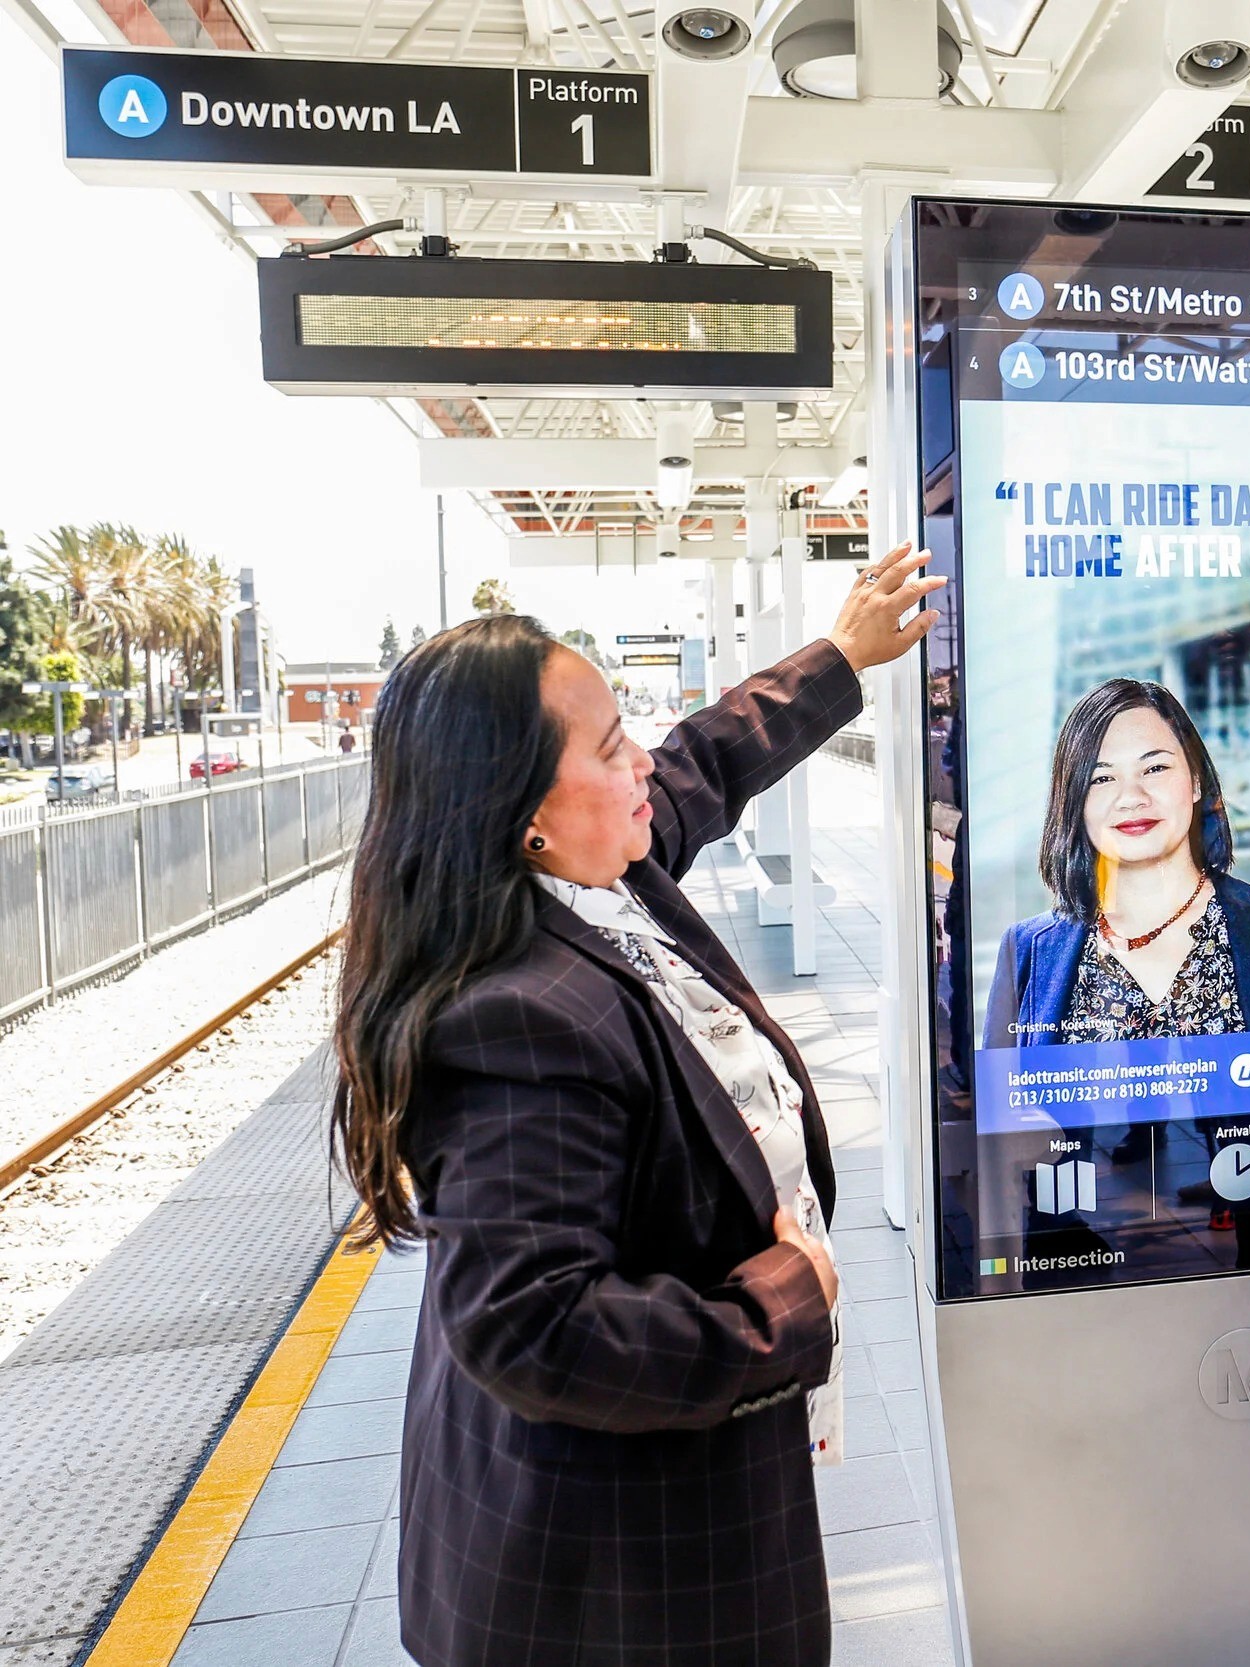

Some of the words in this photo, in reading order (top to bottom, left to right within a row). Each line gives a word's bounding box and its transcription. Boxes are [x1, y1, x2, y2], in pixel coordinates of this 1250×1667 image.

[529, 78, 638, 104] Platform
[117, 89, 149, 124] A
[181, 91, 395, 132] Downtown
[407, 100, 462, 134] LA
[571, 114, 594, 166] 1
[1184, 142, 1216, 191] 2
[968, 287, 978, 301] 3
[1010, 283, 1034, 311] A
[1053, 283, 1102, 312] 7th
[1110, 285, 1242, 317] St/Metro
[969, 356, 979, 370] 4
[1011, 351, 1035, 380] A
[1055, 351, 1135, 381] 103rd
[1044, 482, 1112, 526] CAN
[1122, 483, 1200, 526] RIDE
[1025, 534, 1123, 577] HOME
[1135, 534, 1242, 578] AFTER
[1007, 1021, 1059, 1034] Christine,
[1060, 1017, 1119, 1031] Koreatown
[1008, 1058, 1218, 1087] ladottransit.com/newserviceplan
[1008, 1086, 1100, 1109] (213/310/323
[1103, 1087, 1117, 1099] or
[1119, 1082, 1148, 1099] 818)
[1150, 1077, 1208, 1096] 808-2273
[1050, 1140, 1081, 1153] Maps
[1014, 1249, 1125, 1273] Intersection
